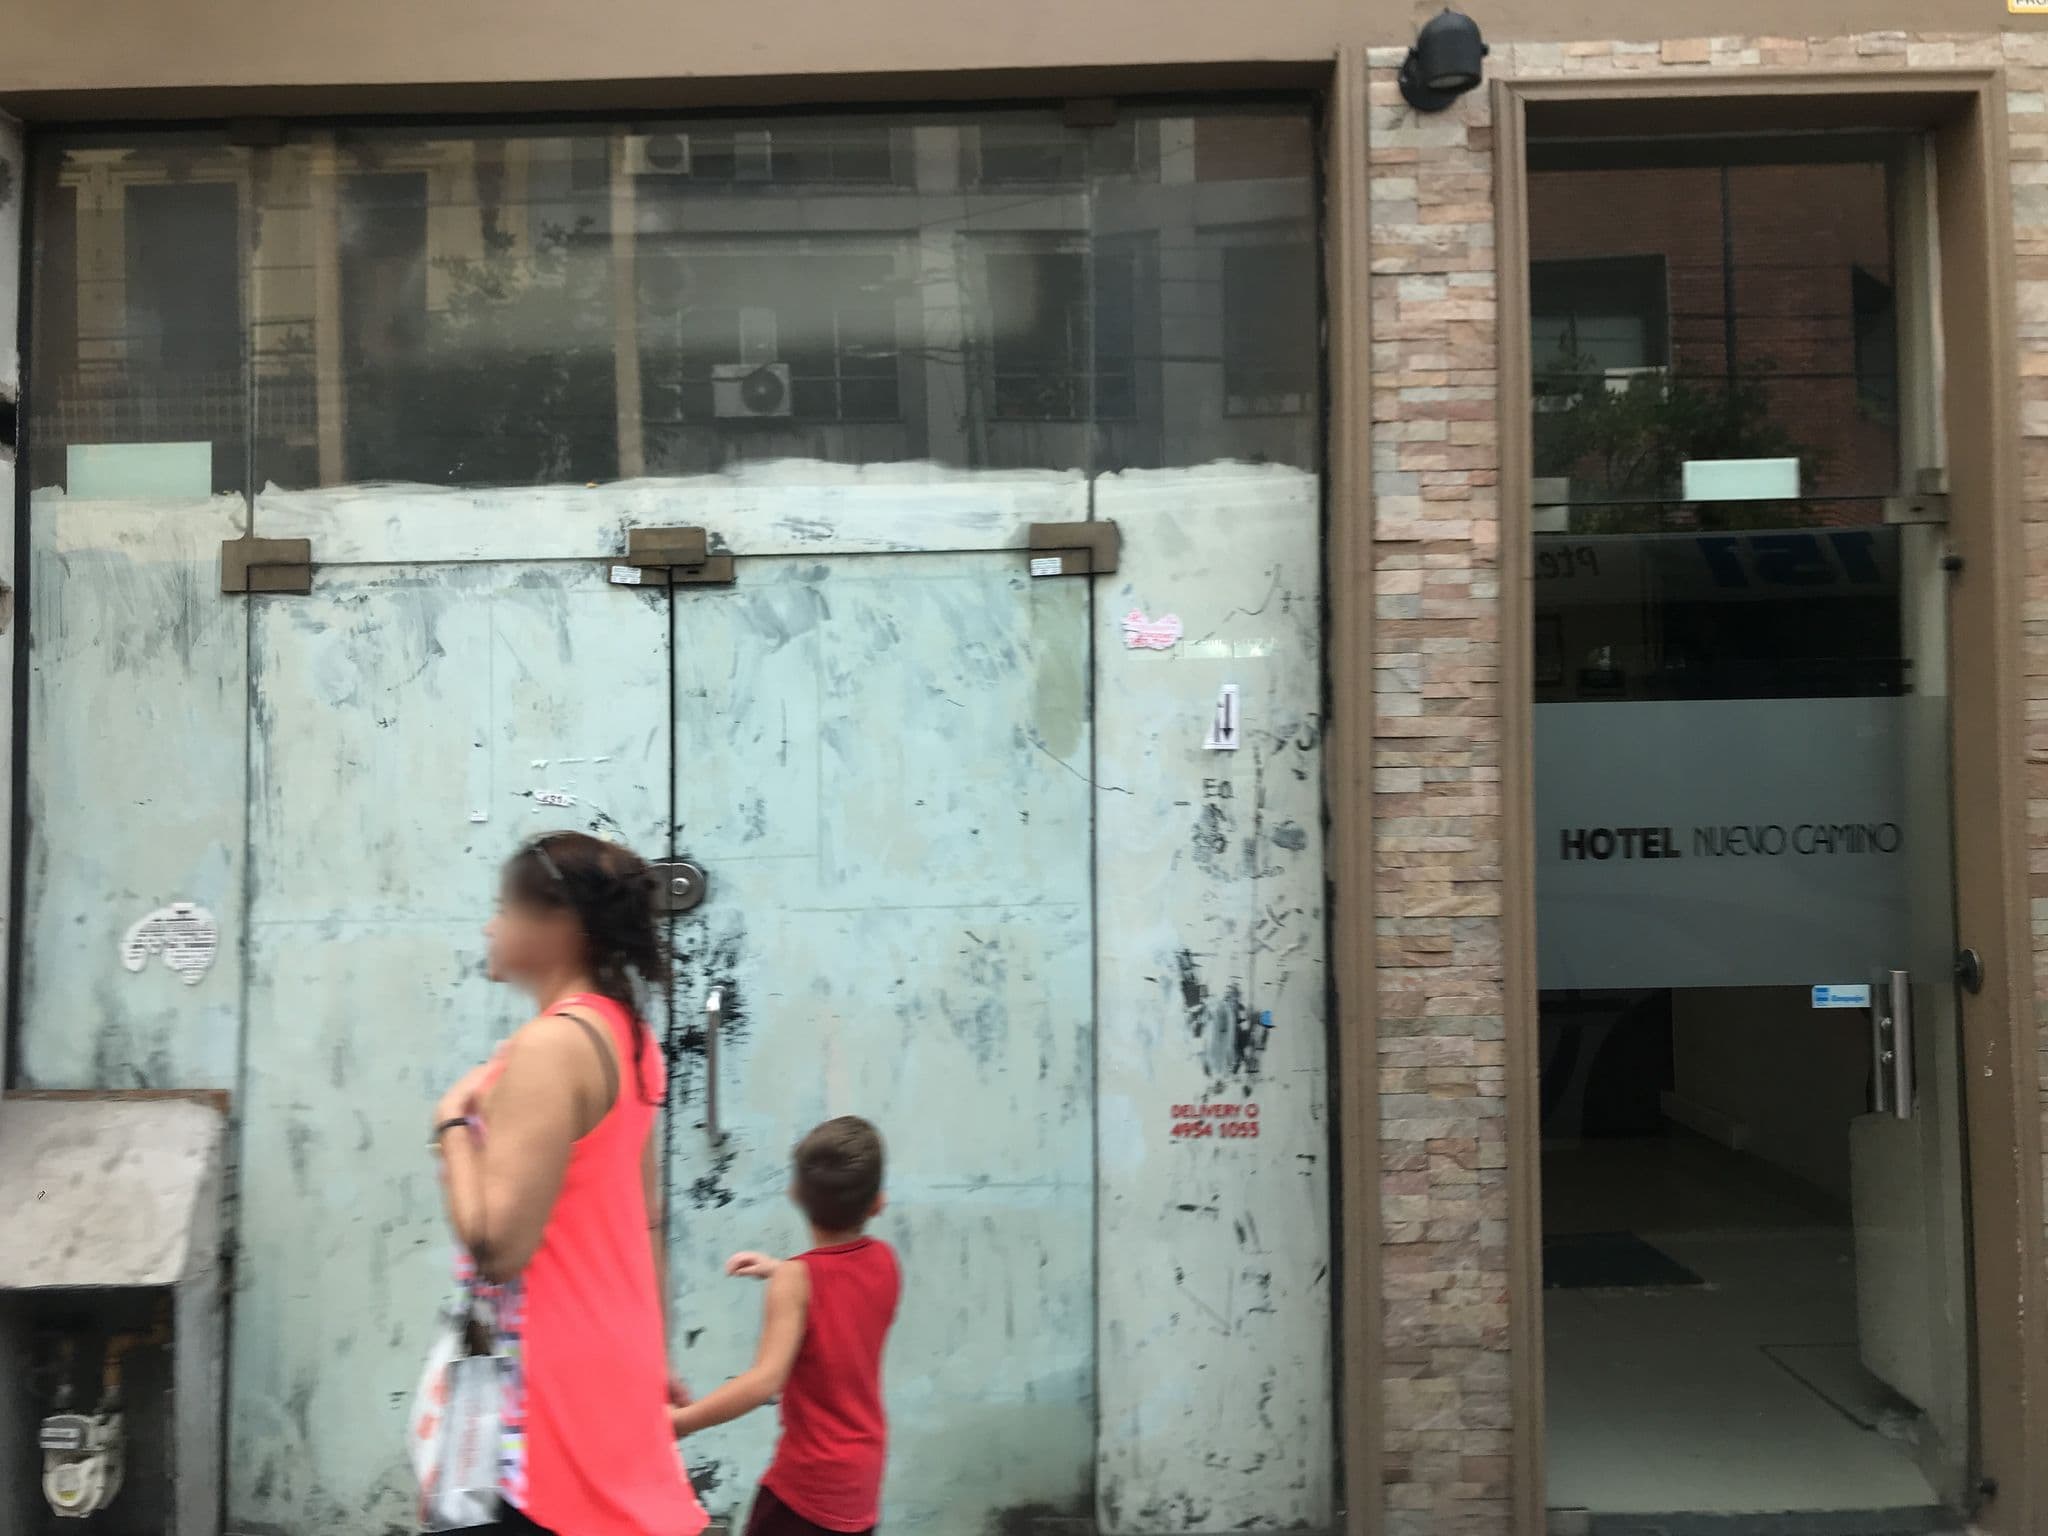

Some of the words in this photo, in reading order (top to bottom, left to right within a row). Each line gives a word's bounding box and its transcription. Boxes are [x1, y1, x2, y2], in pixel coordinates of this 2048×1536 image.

[1560, 827, 1681, 860] HOTEL
[1694, 824, 1788, 857] NUEVO
[1793, 822, 1904, 855] CAMINO
[1171, 1104, 1241, 1118] DELIVERY
